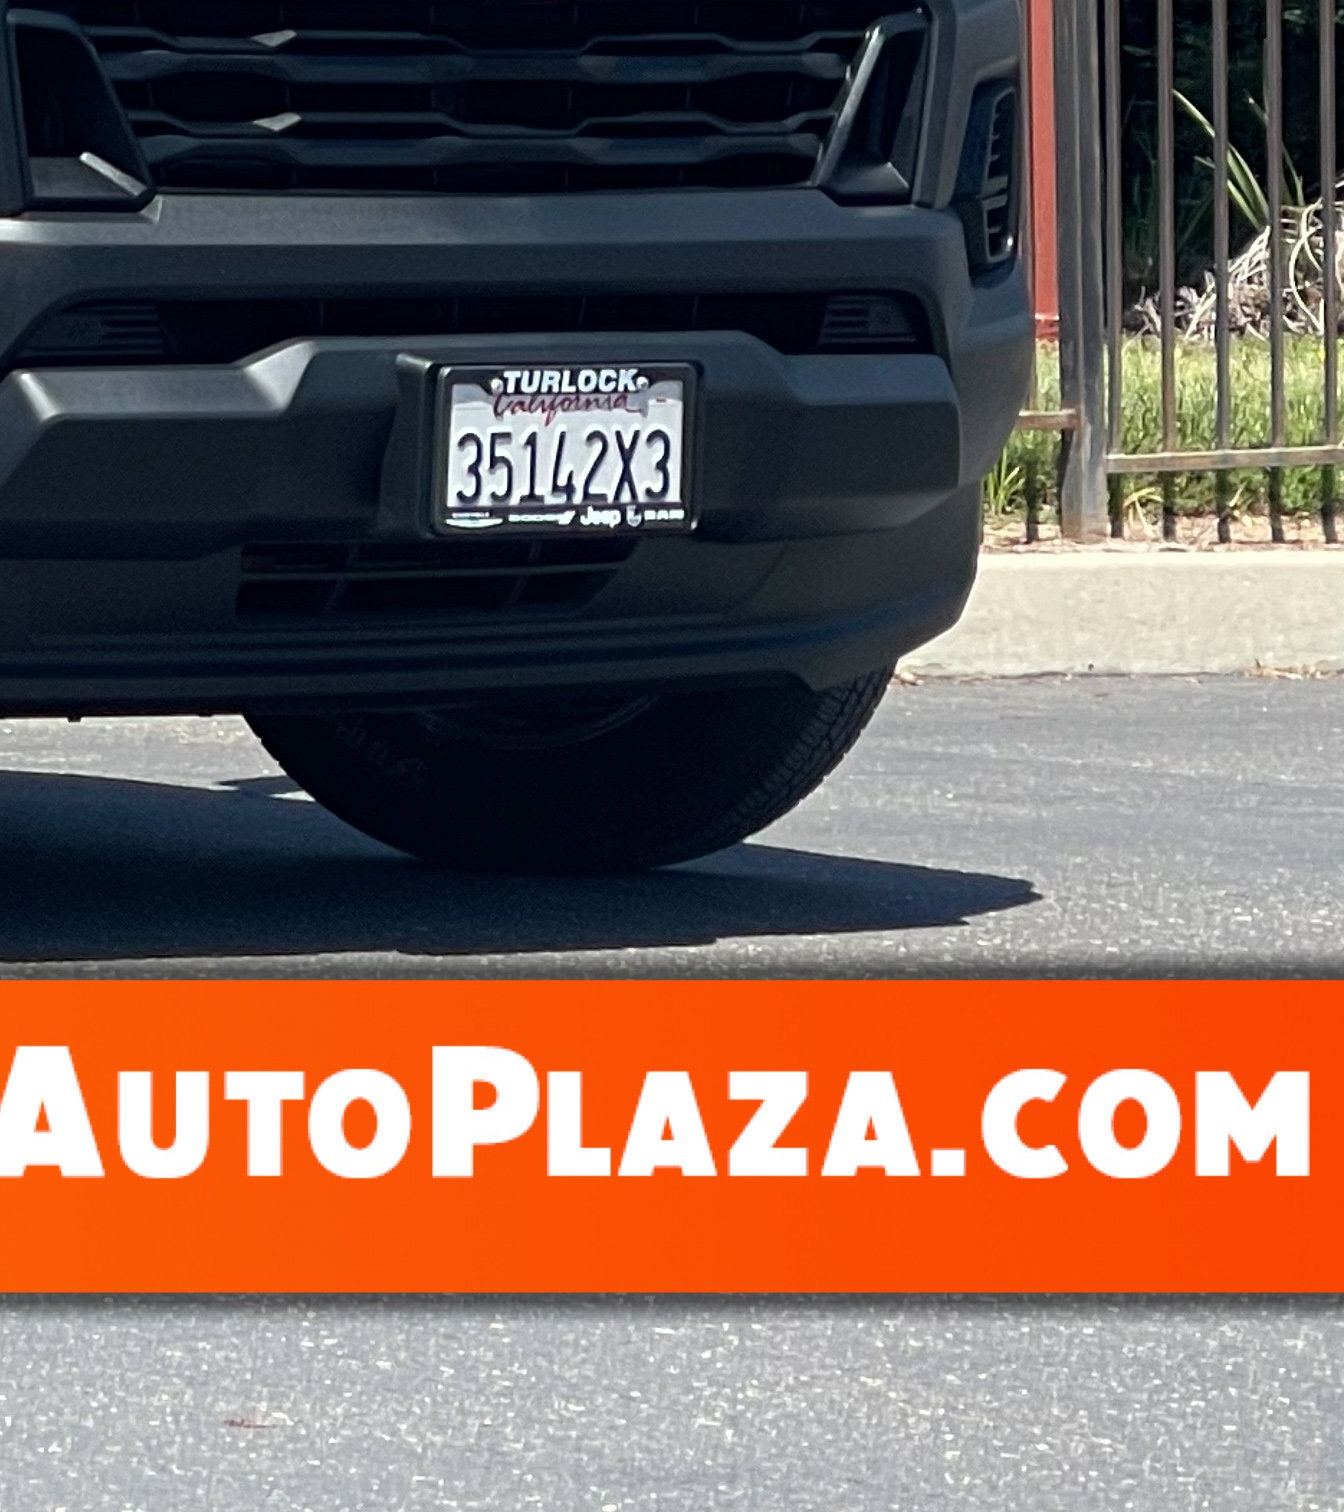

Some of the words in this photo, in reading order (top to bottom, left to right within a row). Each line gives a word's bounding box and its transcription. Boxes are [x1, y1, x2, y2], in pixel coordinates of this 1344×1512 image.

[502, 369, 638, 393] TURLOCK
[491, 392, 648, 426] California
[456, 429, 672, 504] 35142X3
